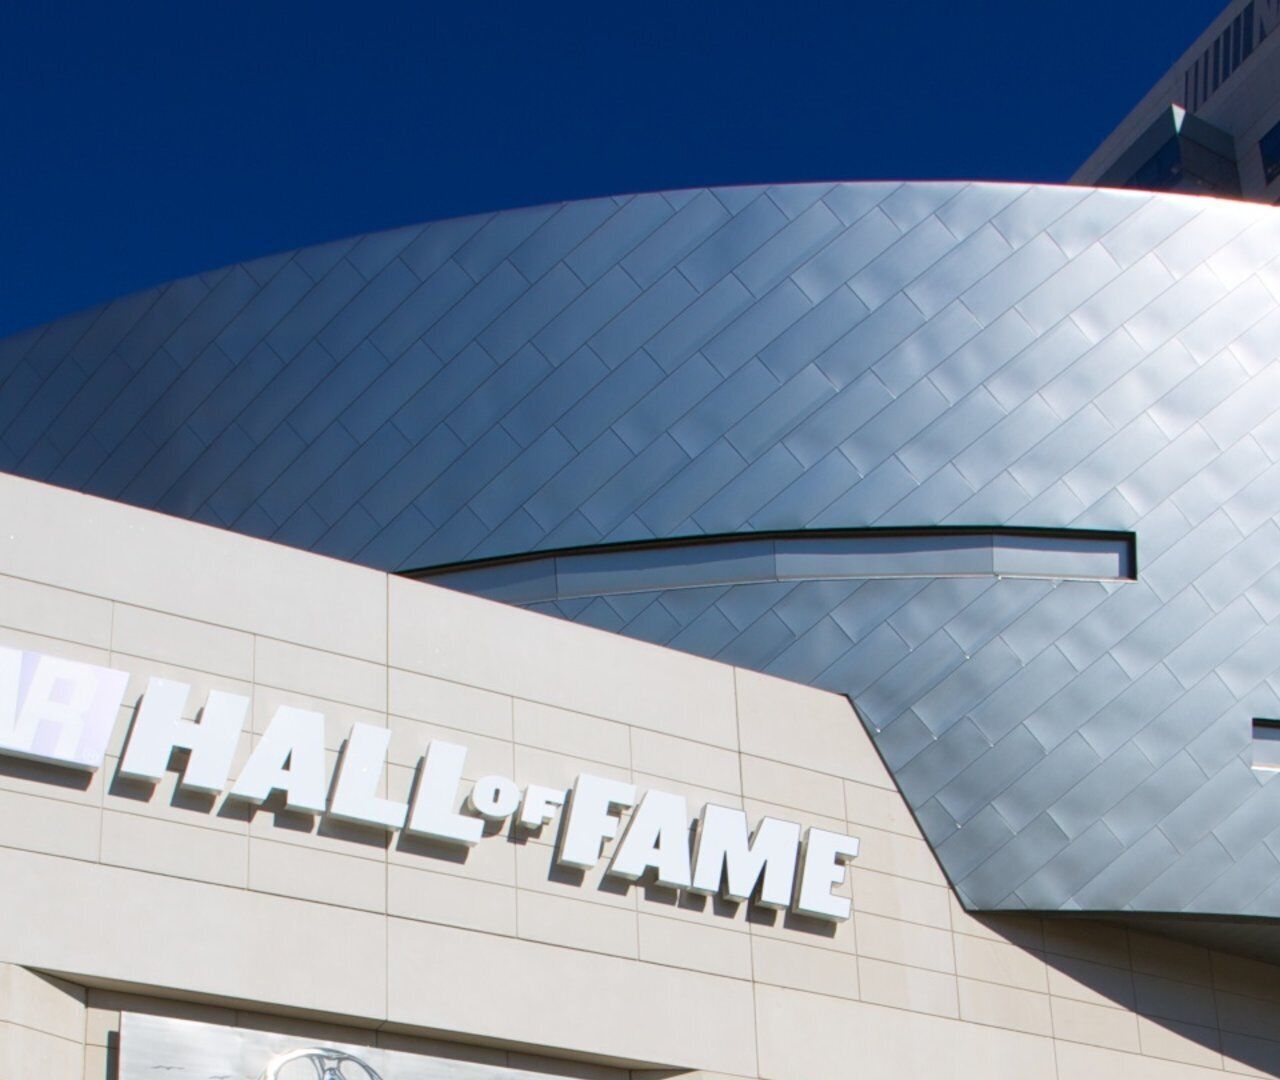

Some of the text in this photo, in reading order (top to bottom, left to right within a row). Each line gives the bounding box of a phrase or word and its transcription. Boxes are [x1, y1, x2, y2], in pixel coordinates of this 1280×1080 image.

[120, 677, 485, 847] HALL
[470, 775, 563, 830] OF
[558, 773, 860, 922] FAME
